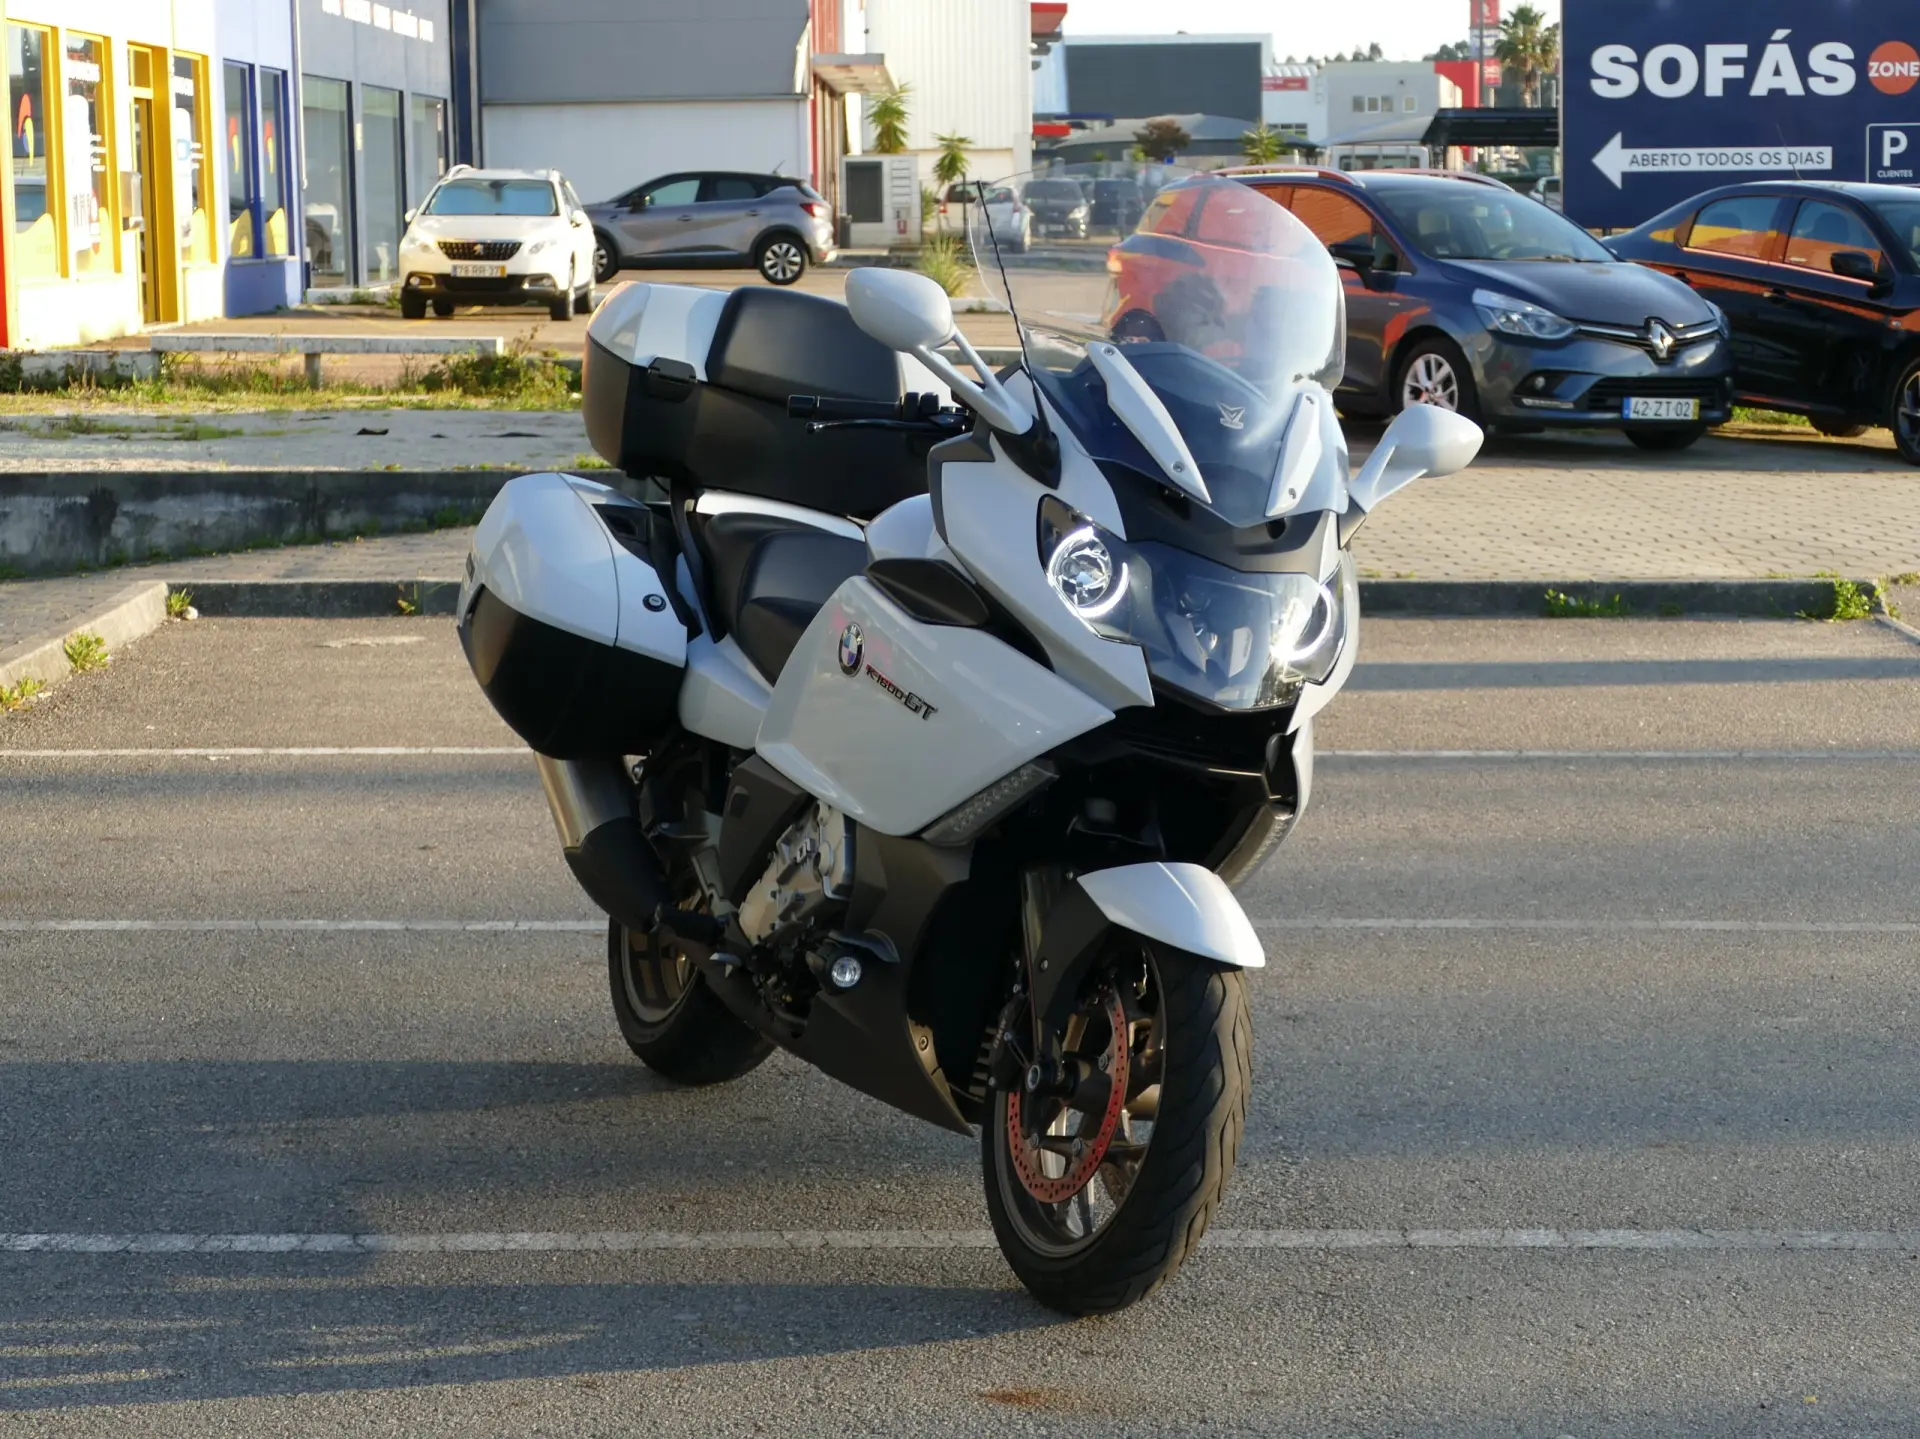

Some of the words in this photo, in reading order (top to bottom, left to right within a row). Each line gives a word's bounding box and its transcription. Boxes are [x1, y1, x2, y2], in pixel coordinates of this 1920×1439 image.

[1590, 29, 1857, 98] SOFÁS
[1868, 61, 1920, 77] ZONE
[1882, 130, 1908, 167] P
[1629, 153, 1692, 167] ABERTO
[1697, 152, 1754, 166] TODOS
[1759, 151, 1782, 165] OS
[1788, 151, 1825, 165] DIAS
[1877, 169, 1913, 178] CLIENTES
